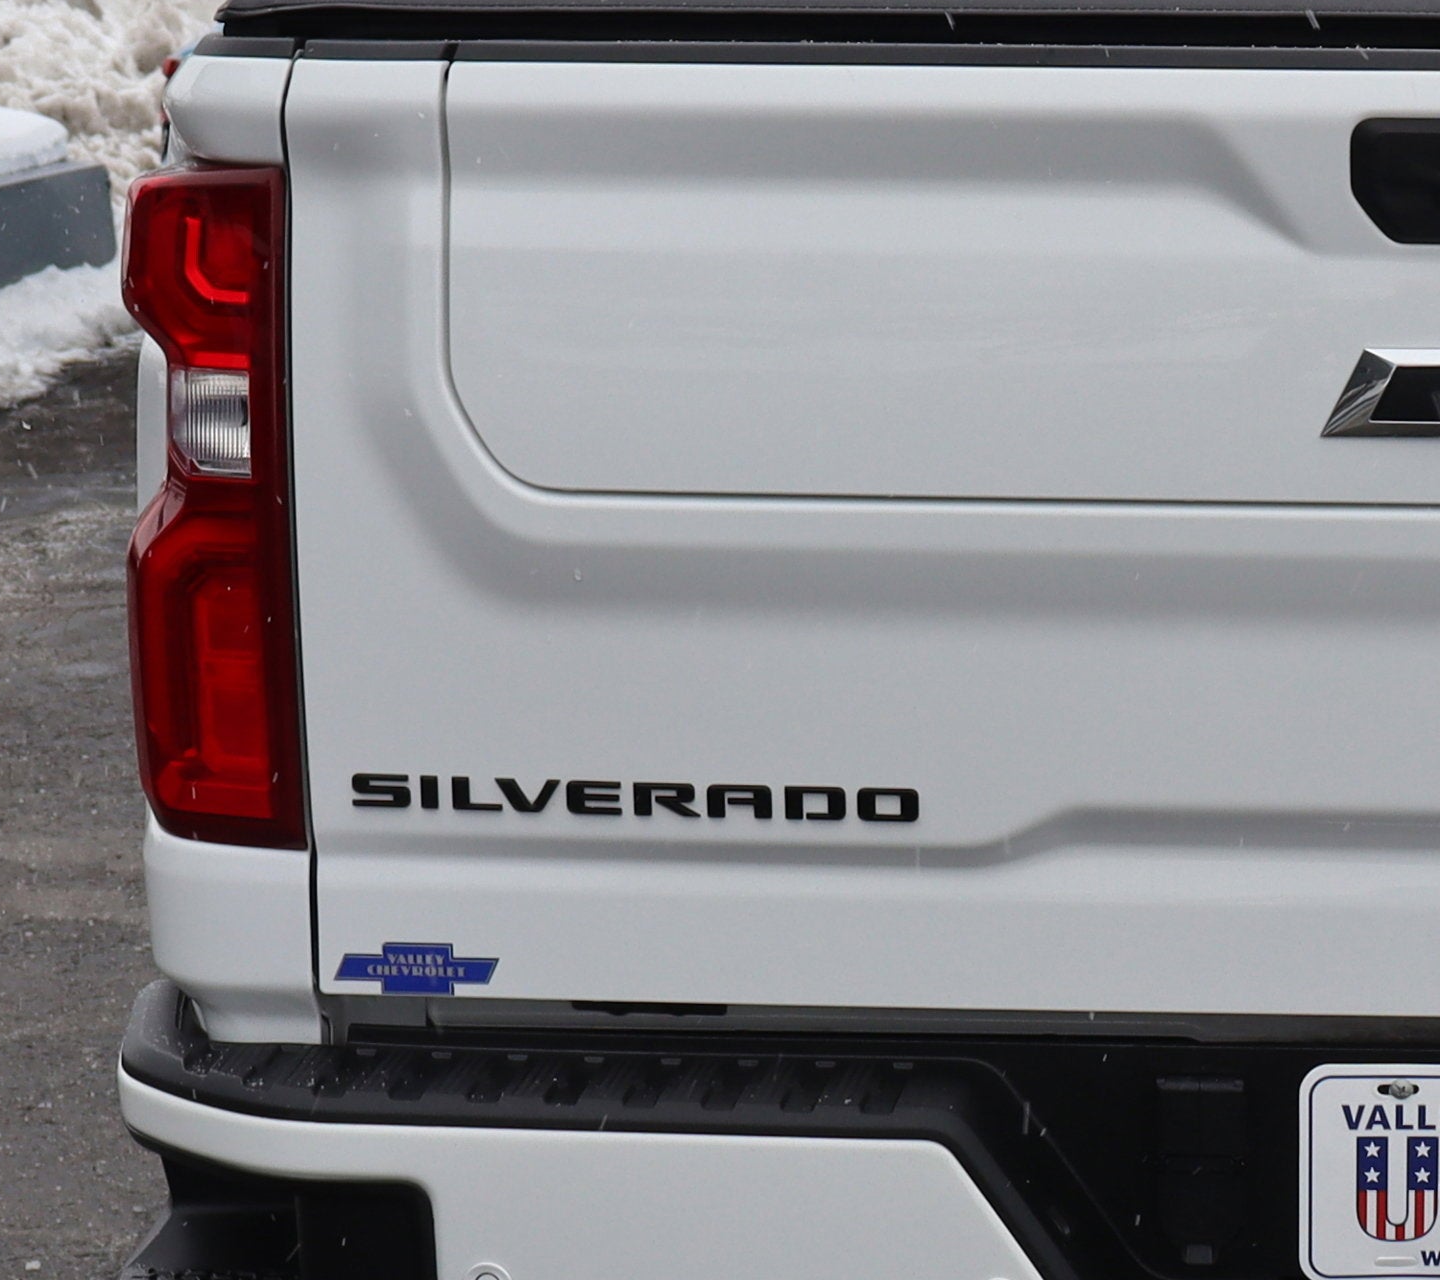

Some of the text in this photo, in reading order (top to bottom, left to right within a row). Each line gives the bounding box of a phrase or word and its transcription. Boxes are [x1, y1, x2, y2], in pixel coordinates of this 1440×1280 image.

[351, 772, 920, 823] SILVERADO
[386, 953, 445, 965] VALLEY
[366, 964, 466, 978] CHEVROLET
